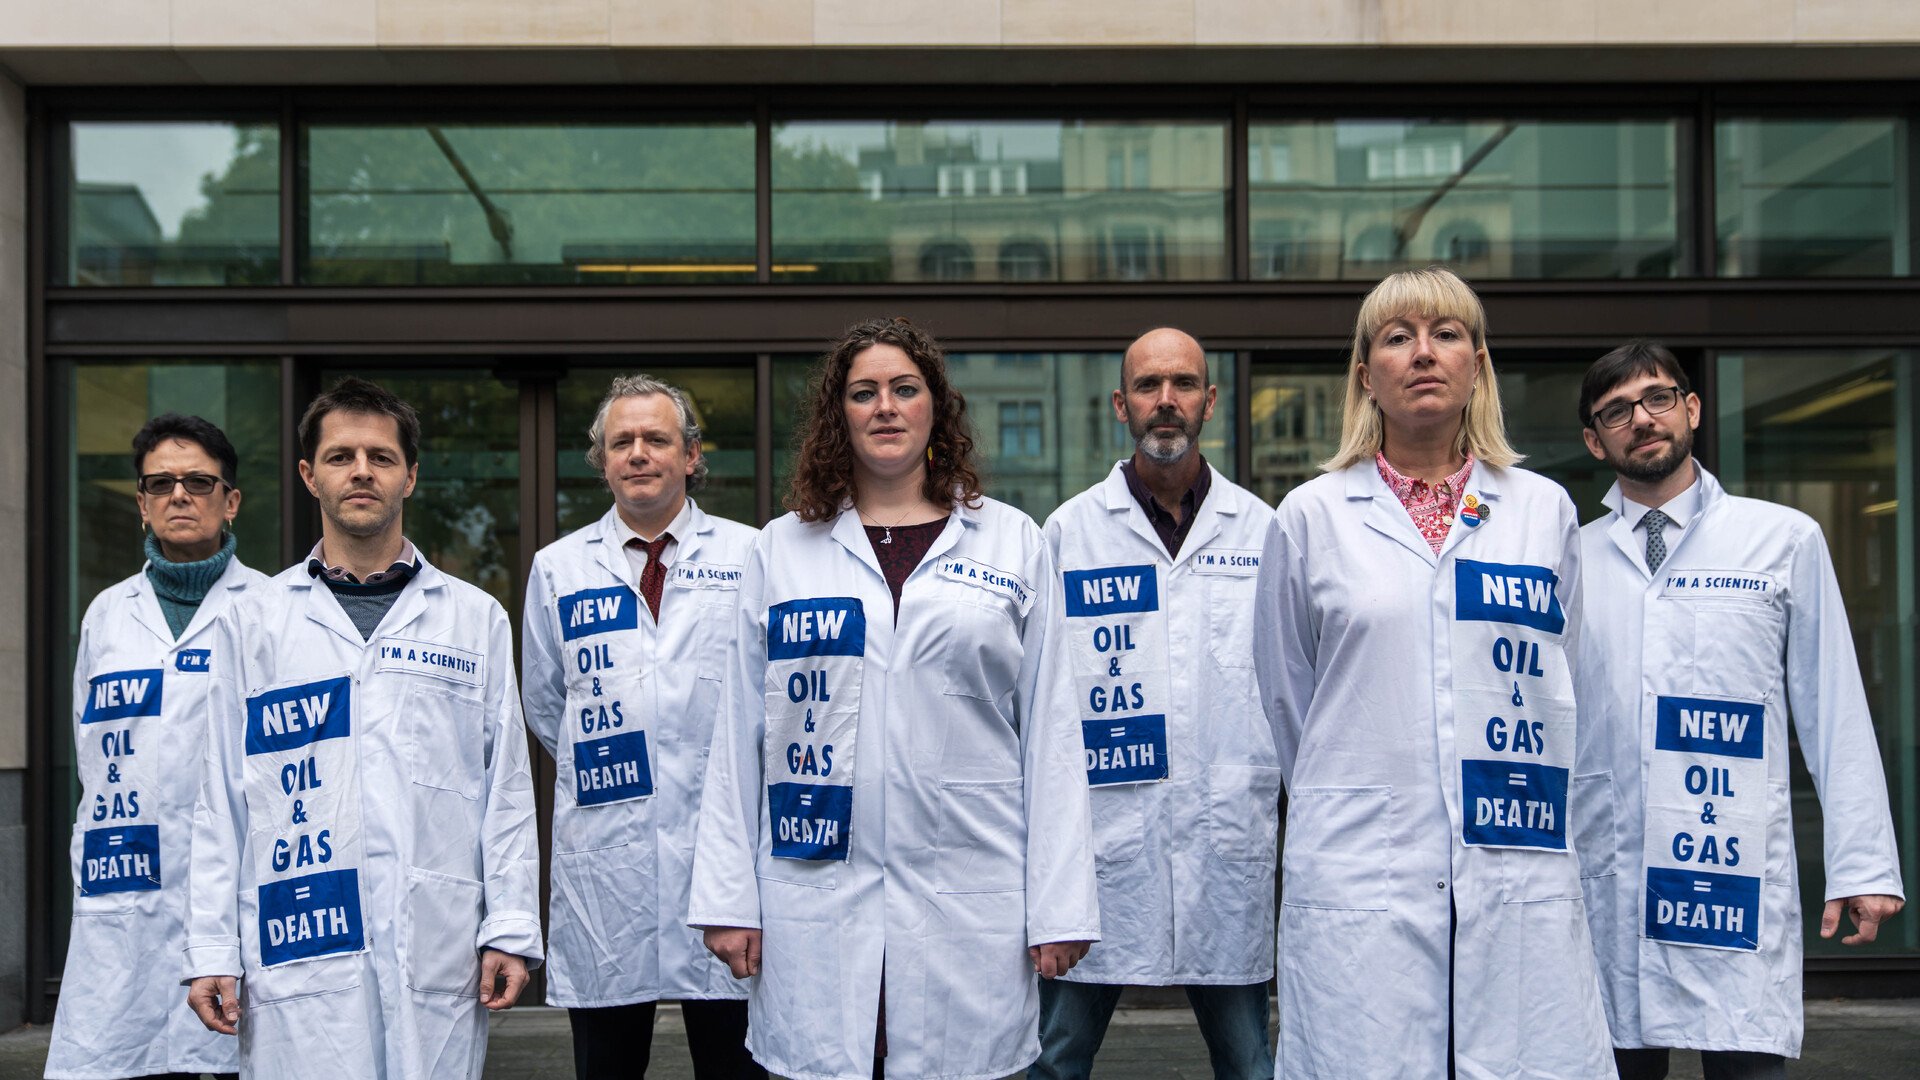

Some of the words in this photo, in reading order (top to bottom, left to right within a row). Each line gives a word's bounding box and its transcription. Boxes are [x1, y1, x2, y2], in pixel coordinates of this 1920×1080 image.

[678, 568, 694, 579] I'M
[697, 569, 705, 578] A
[944, 562, 963, 575] I'M
[968, 568, 977, 578] A
[1198, 555, 1215, 565] I'M
[1219, 556, 1227, 565] A
[1082, 575, 1141, 605] NEW
[1481, 572, 1552, 614] NEW
[1666, 577, 1686, 588] I'M
[1690, 577, 1699, 588] A
[1705, 577, 1768, 592] SCIENTIST
[569, 595, 622, 628] NEW
[782, 609, 847, 643] NEW
[1093, 624, 1136, 653] OIL
[182, 655, 200, 666] I'M
[381, 646, 402, 659] I'M
[407, 649, 416, 661] A
[422, 651, 476, 674] SCIENTIST
[577, 643, 614, 674] OIL
[1108, 656, 1122, 678] &
[1492, 636, 1544, 678] OIL
[94, 677, 150, 710] NEW
[592, 676, 603, 697] &
[787, 669, 831, 704] OIL
[1089, 682, 1145, 713] GAS
[1511, 680, 1524, 707] &
[261, 691, 331, 737] NEW
[580, 700, 624, 734] GAS
[804, 708, 816, 733] &
[1679, 708, 1750, 743] NEW
[102, 729, 135, 759] OIL
[1485, 716, 1544, 756] GAS
[107, 762, 121, 783] &
[786, 742, 834, 777] GAS
[1085, 743, 1155, 771] DEATH
[280, 756, 322, 796] OIL
[579, 760, 640, 792] DEATH
[1684, 764, 1735, 798] OIL
[92, 790, 139, 821] GAS
[292, 799, 308, 825] &
[1475, 796, 1555, 831] DEATH
[1700, 801, 1717, 825] &
[778, 815, 839, 846] DEATH
[272, 829, 332, 872] GAS
[1671, 831, 1741, 867] GAS
[86, 853, 151, 882] DEATH
[266, 906, 349, 947] DEATH
[1656, 899, 1745, 934] DEATH
